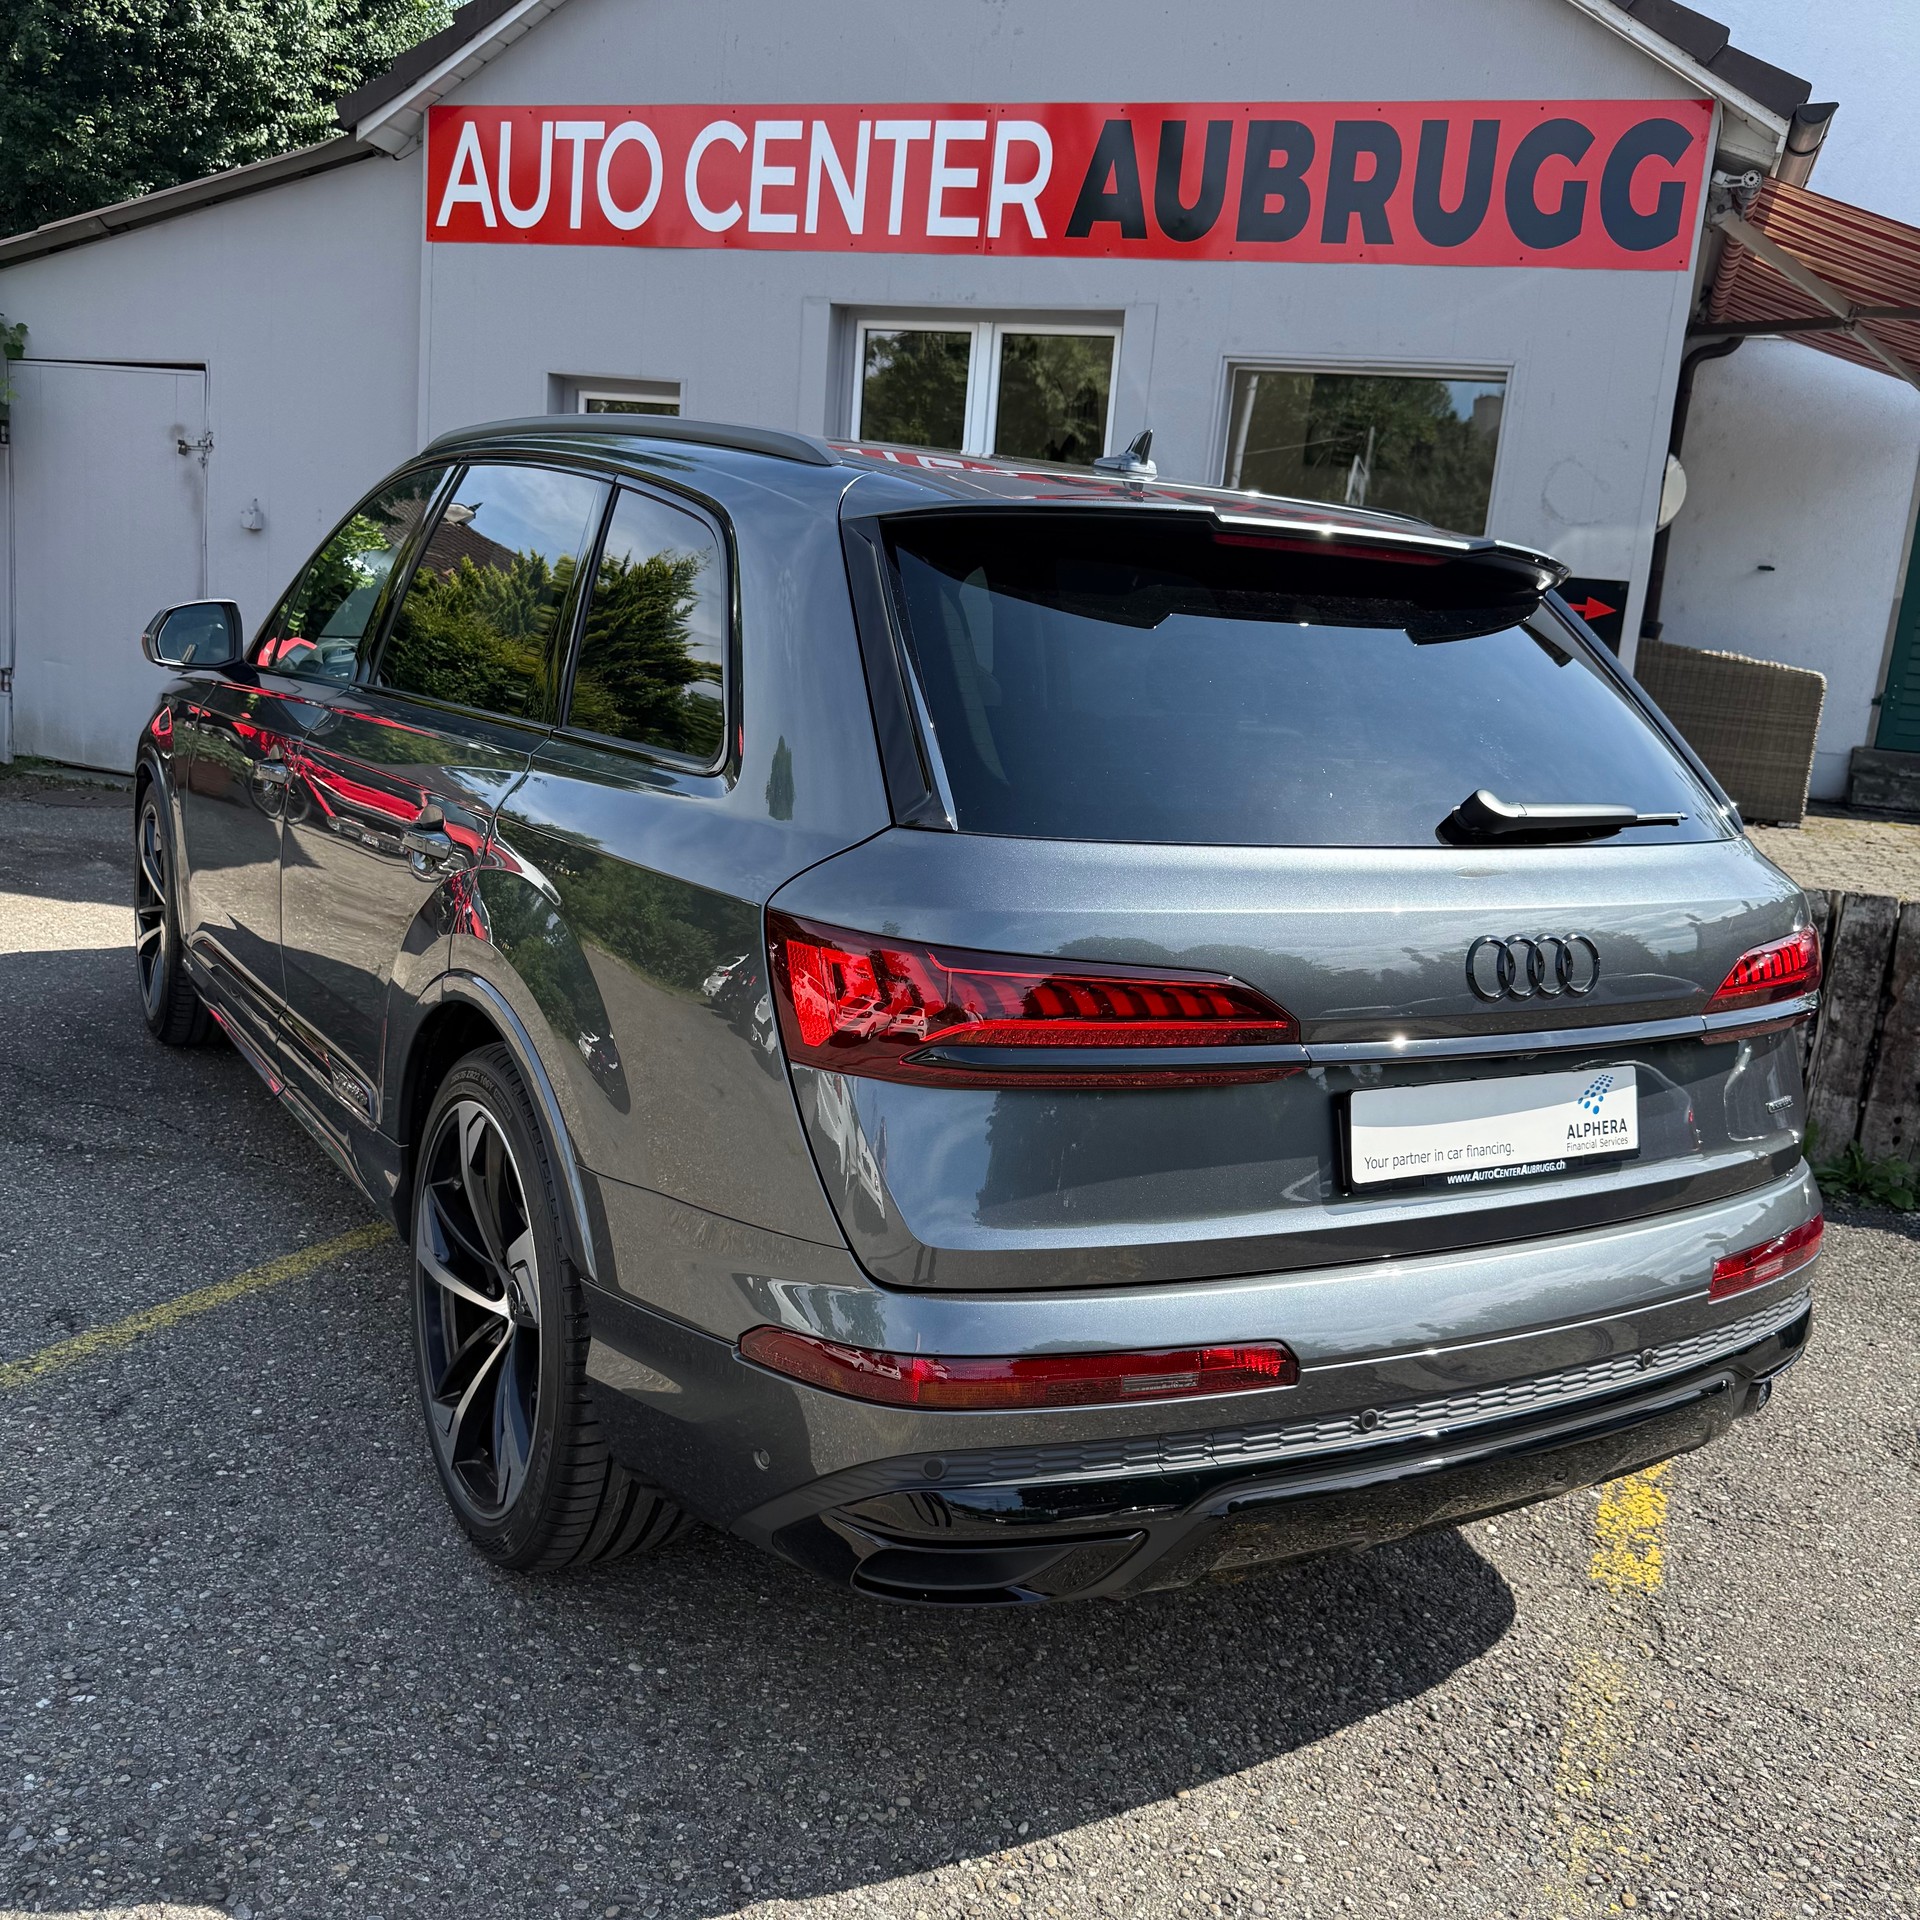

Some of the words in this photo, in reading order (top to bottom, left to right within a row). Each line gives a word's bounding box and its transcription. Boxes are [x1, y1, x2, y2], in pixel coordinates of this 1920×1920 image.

[435, 120, 664, 231] AUTO
[684, 119, 1054, 240] CENTER
[1064, 117, 1695, 252] AUBRUGG
[1566, 1118, 1628, 1140] ALPHERA
[1364, 1156, 1390, 1170] Your
[1392, 1151, 1432, 1170] partner
[1434, 1148, 1444, 1162] in
[1447, 1147, 1463, 1160] car
[1466, 1141, 1515, 1157] financing.
[1566, 1138, 1598, 1152] Financial
[1599, 1135, 1629, 1148] Services
